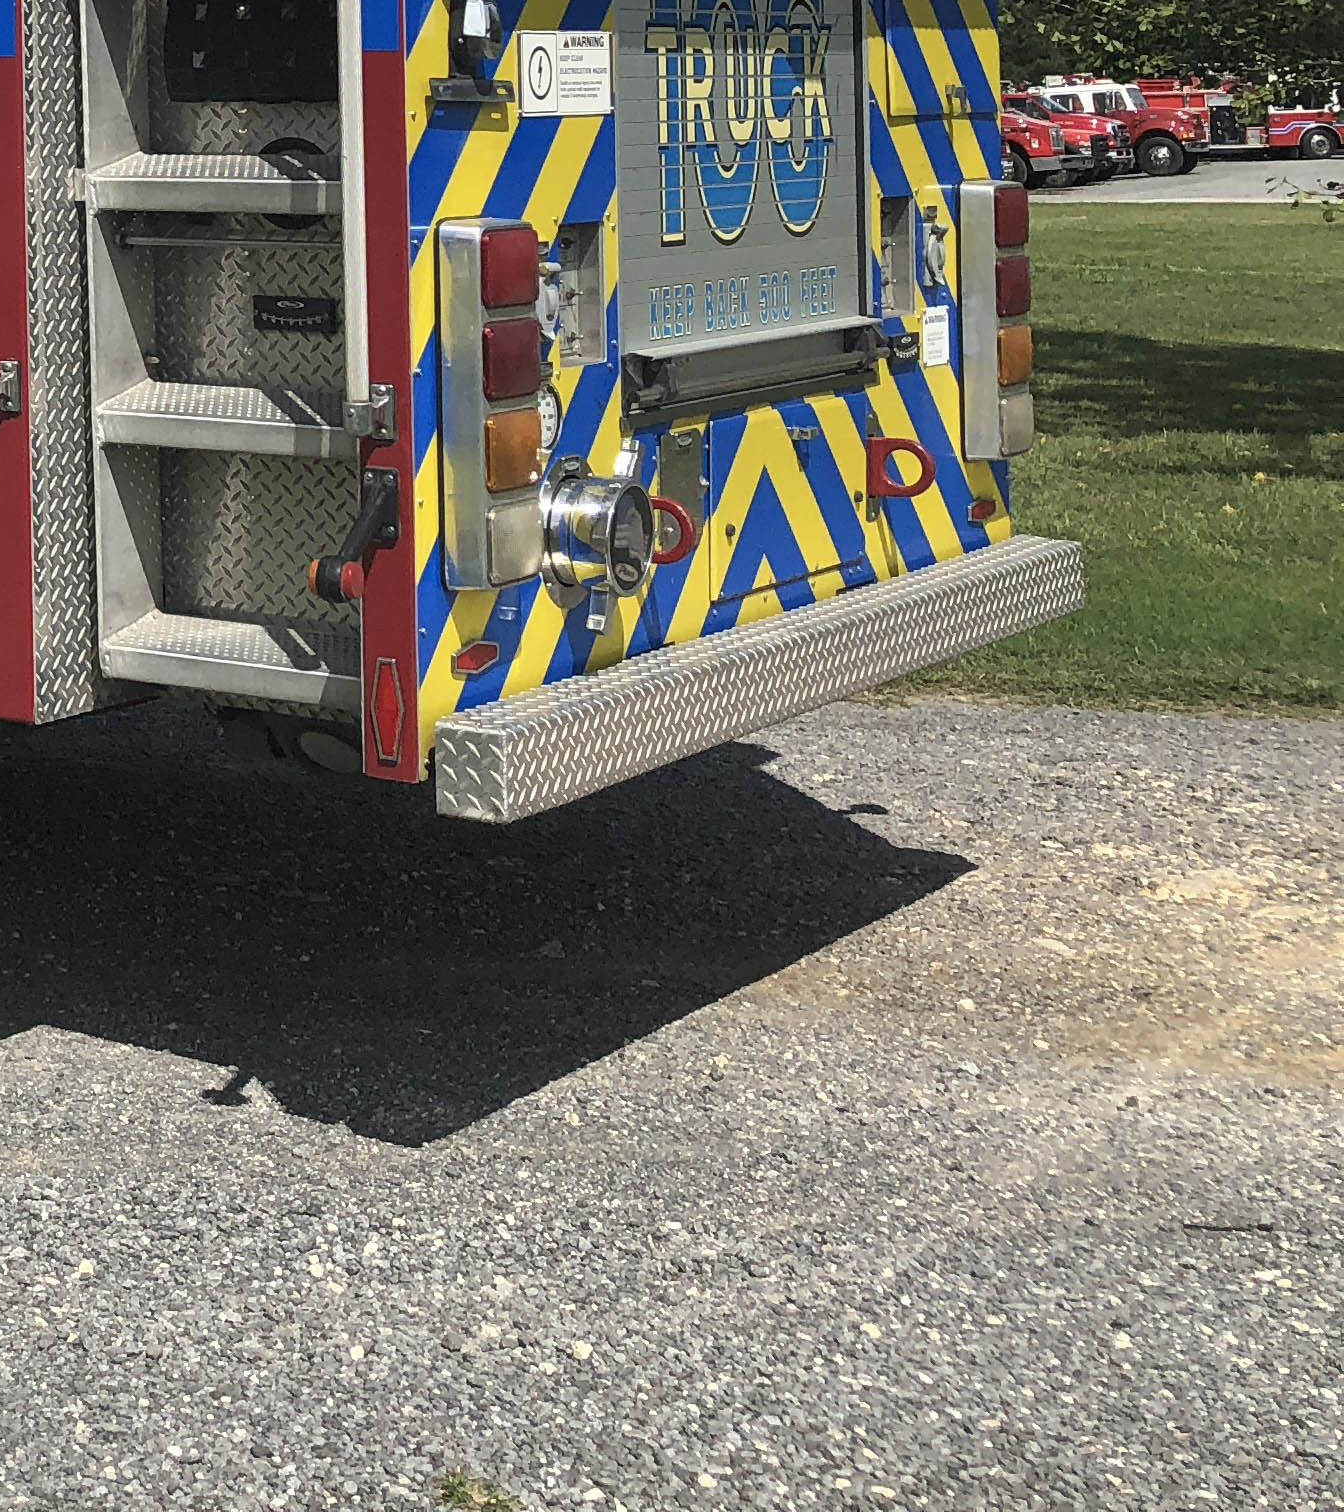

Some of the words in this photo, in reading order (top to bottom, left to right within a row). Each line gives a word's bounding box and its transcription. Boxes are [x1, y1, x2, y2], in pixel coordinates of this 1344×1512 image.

[570, 36, 605, 47] WARNING
[645, 22, 833, 150] TRUCK
[648, 283, 695, 341] KEEP
[704, 276, 751, 332] BACK
[759, 270, 792, 325] 500
[799, 264, 837, 318] FEET
